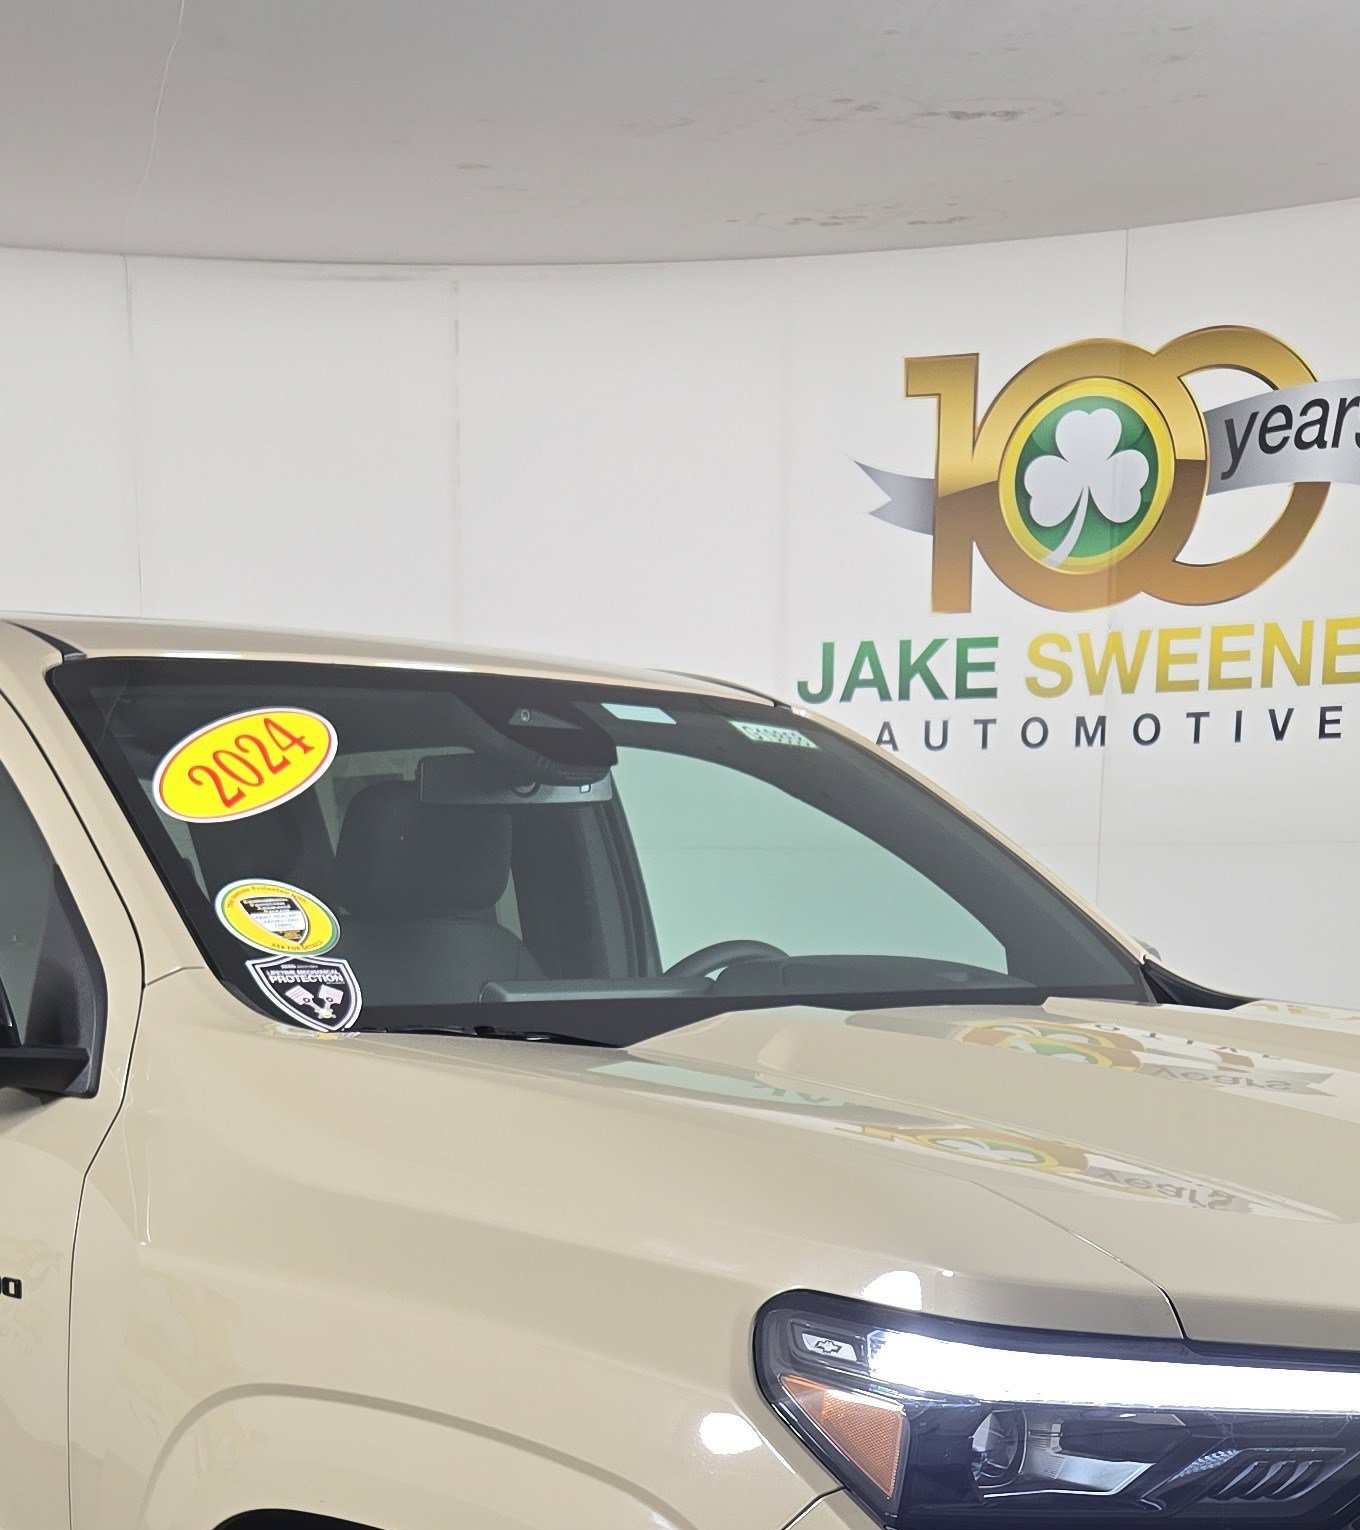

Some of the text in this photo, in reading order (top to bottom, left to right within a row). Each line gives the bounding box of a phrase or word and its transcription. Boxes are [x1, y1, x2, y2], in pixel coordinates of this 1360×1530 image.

[797, 636, 1000, 705] JAKE
[875, 705, 1344, 752] AUTOMOTIVE
[188, 716, 314, 808] 2024
[269, 973, 344, 984] PROTECTION
